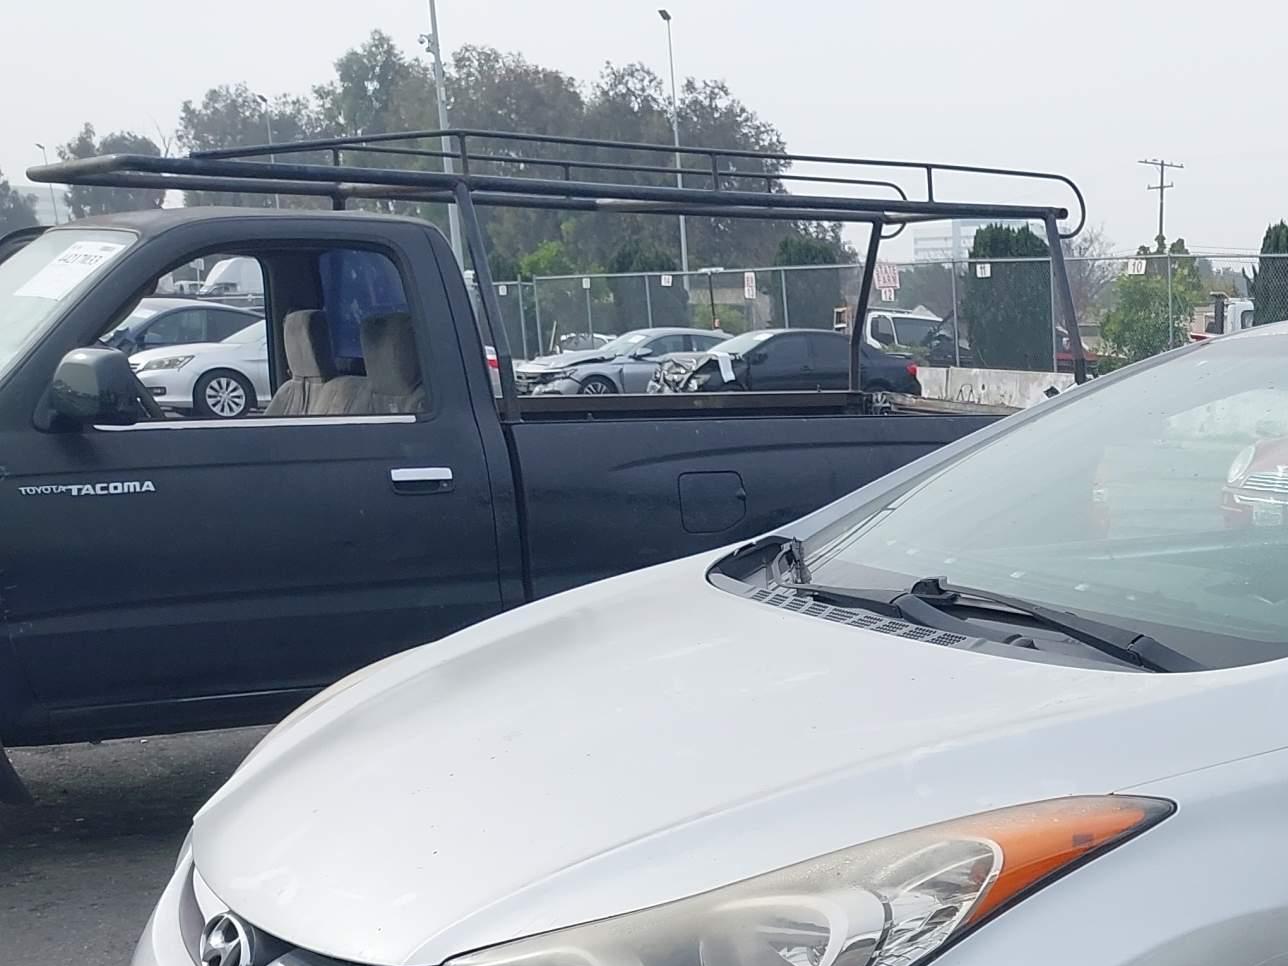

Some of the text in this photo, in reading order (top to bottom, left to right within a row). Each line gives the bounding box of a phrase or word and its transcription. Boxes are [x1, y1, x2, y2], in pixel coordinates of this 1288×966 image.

[1132, 261, 1143, 273] 10
[18, 480, 156, 496] TOYOTA TACOMA
